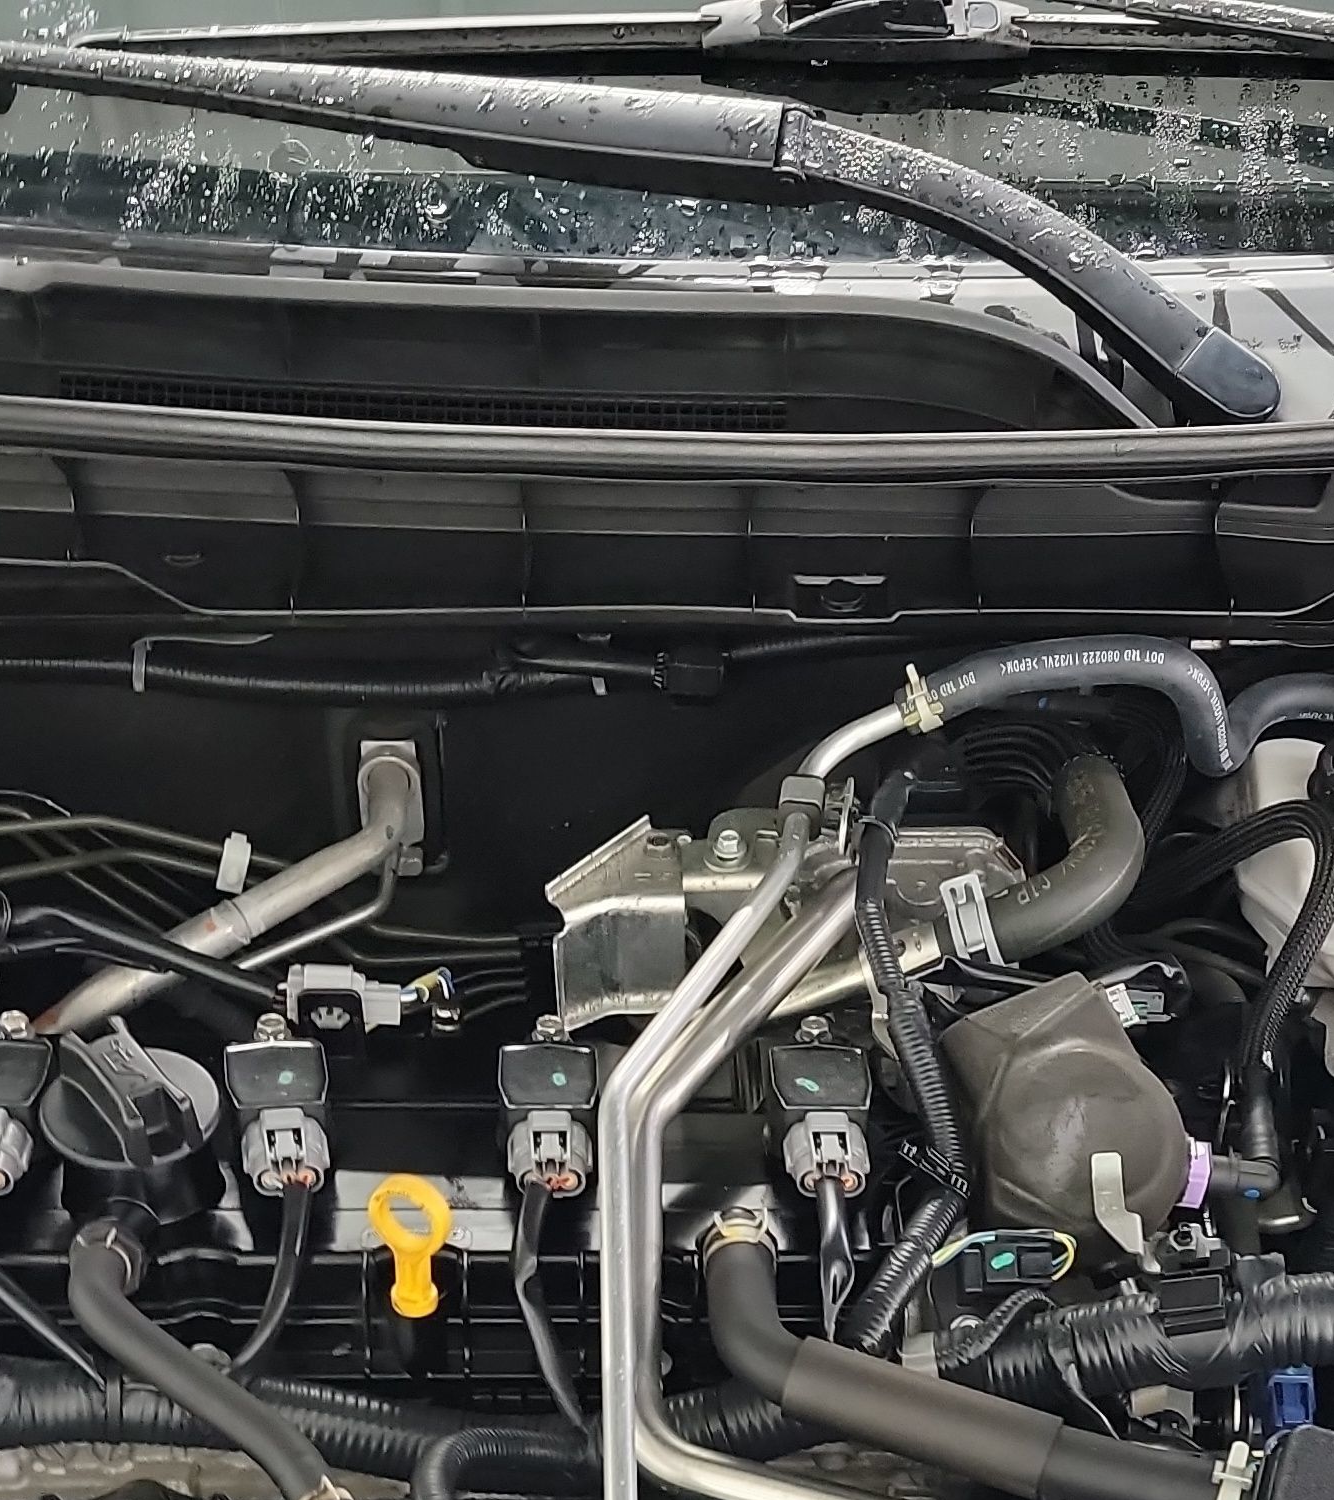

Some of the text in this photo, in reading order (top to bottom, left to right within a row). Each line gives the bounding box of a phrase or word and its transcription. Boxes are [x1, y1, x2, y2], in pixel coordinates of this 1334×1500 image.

[1082, 649, 1121, 666] 080222
[1145, 649, 1165, 665] DOT
[957, 670, 976, 689] DOT
